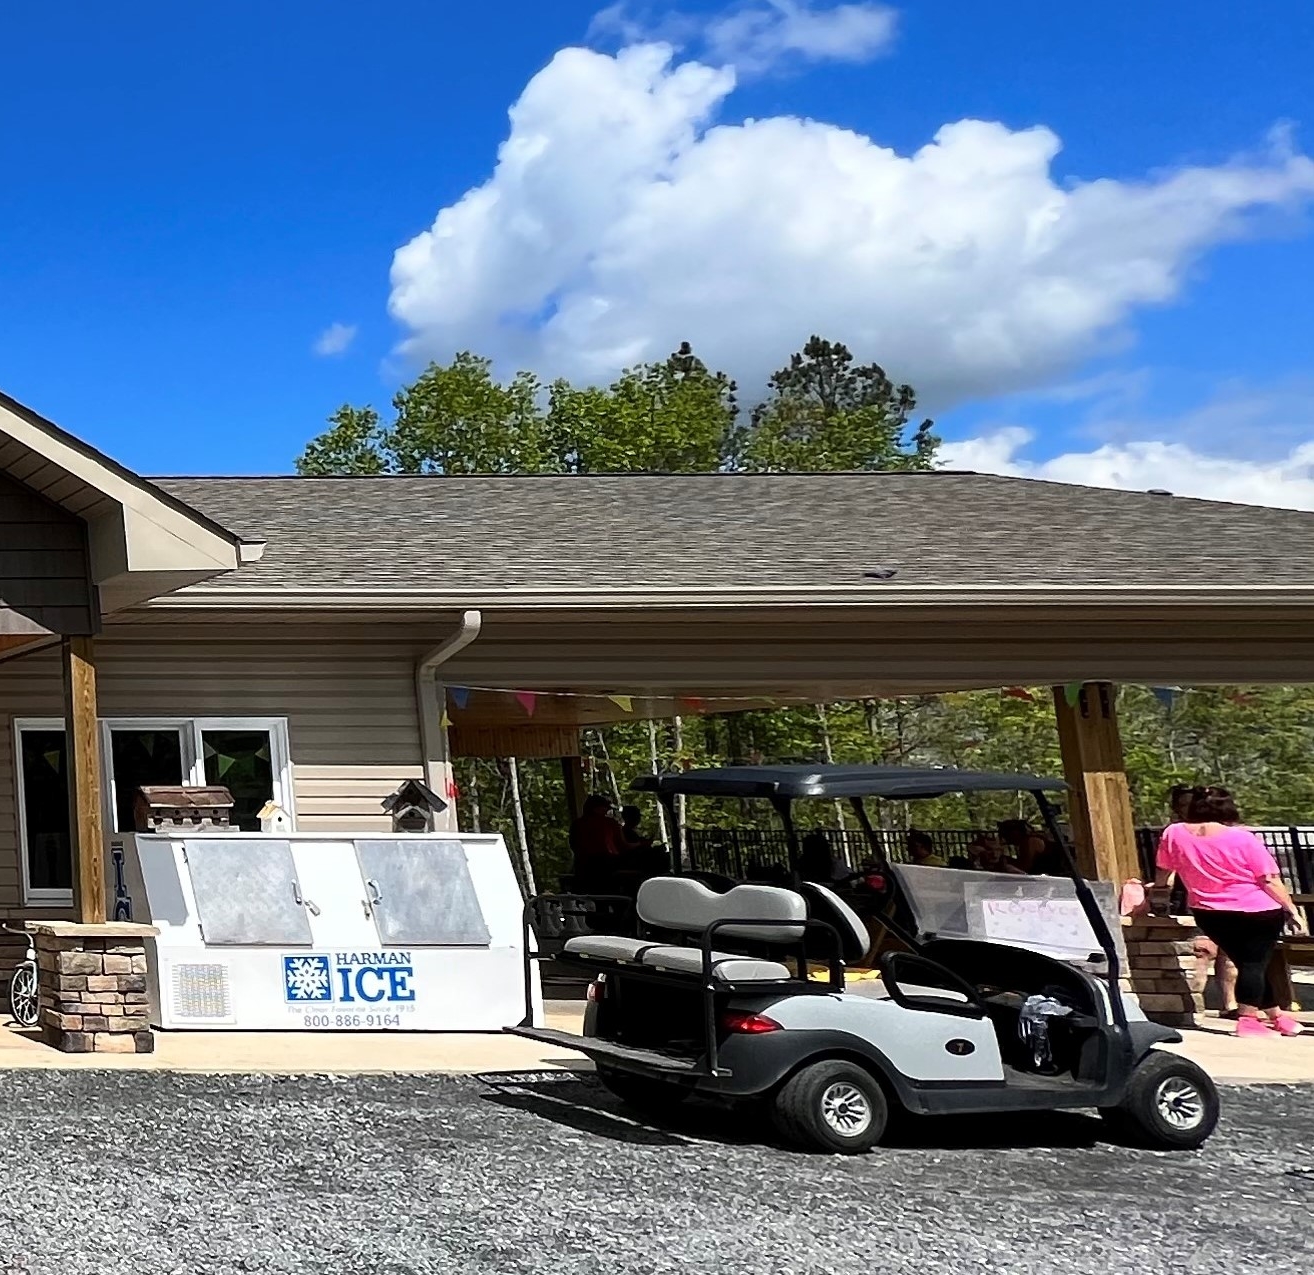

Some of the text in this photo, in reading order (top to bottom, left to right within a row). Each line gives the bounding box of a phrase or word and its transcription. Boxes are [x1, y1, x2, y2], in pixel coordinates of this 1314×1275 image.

[335, 952, 412, 965] HARMAN
[337, 966, 416, 1002] ICE
[288, 1006, 302, 1014] The
[303, 1014, 401, 1027] 800-886-9164
[956, 1042, 965, 1053] 7
